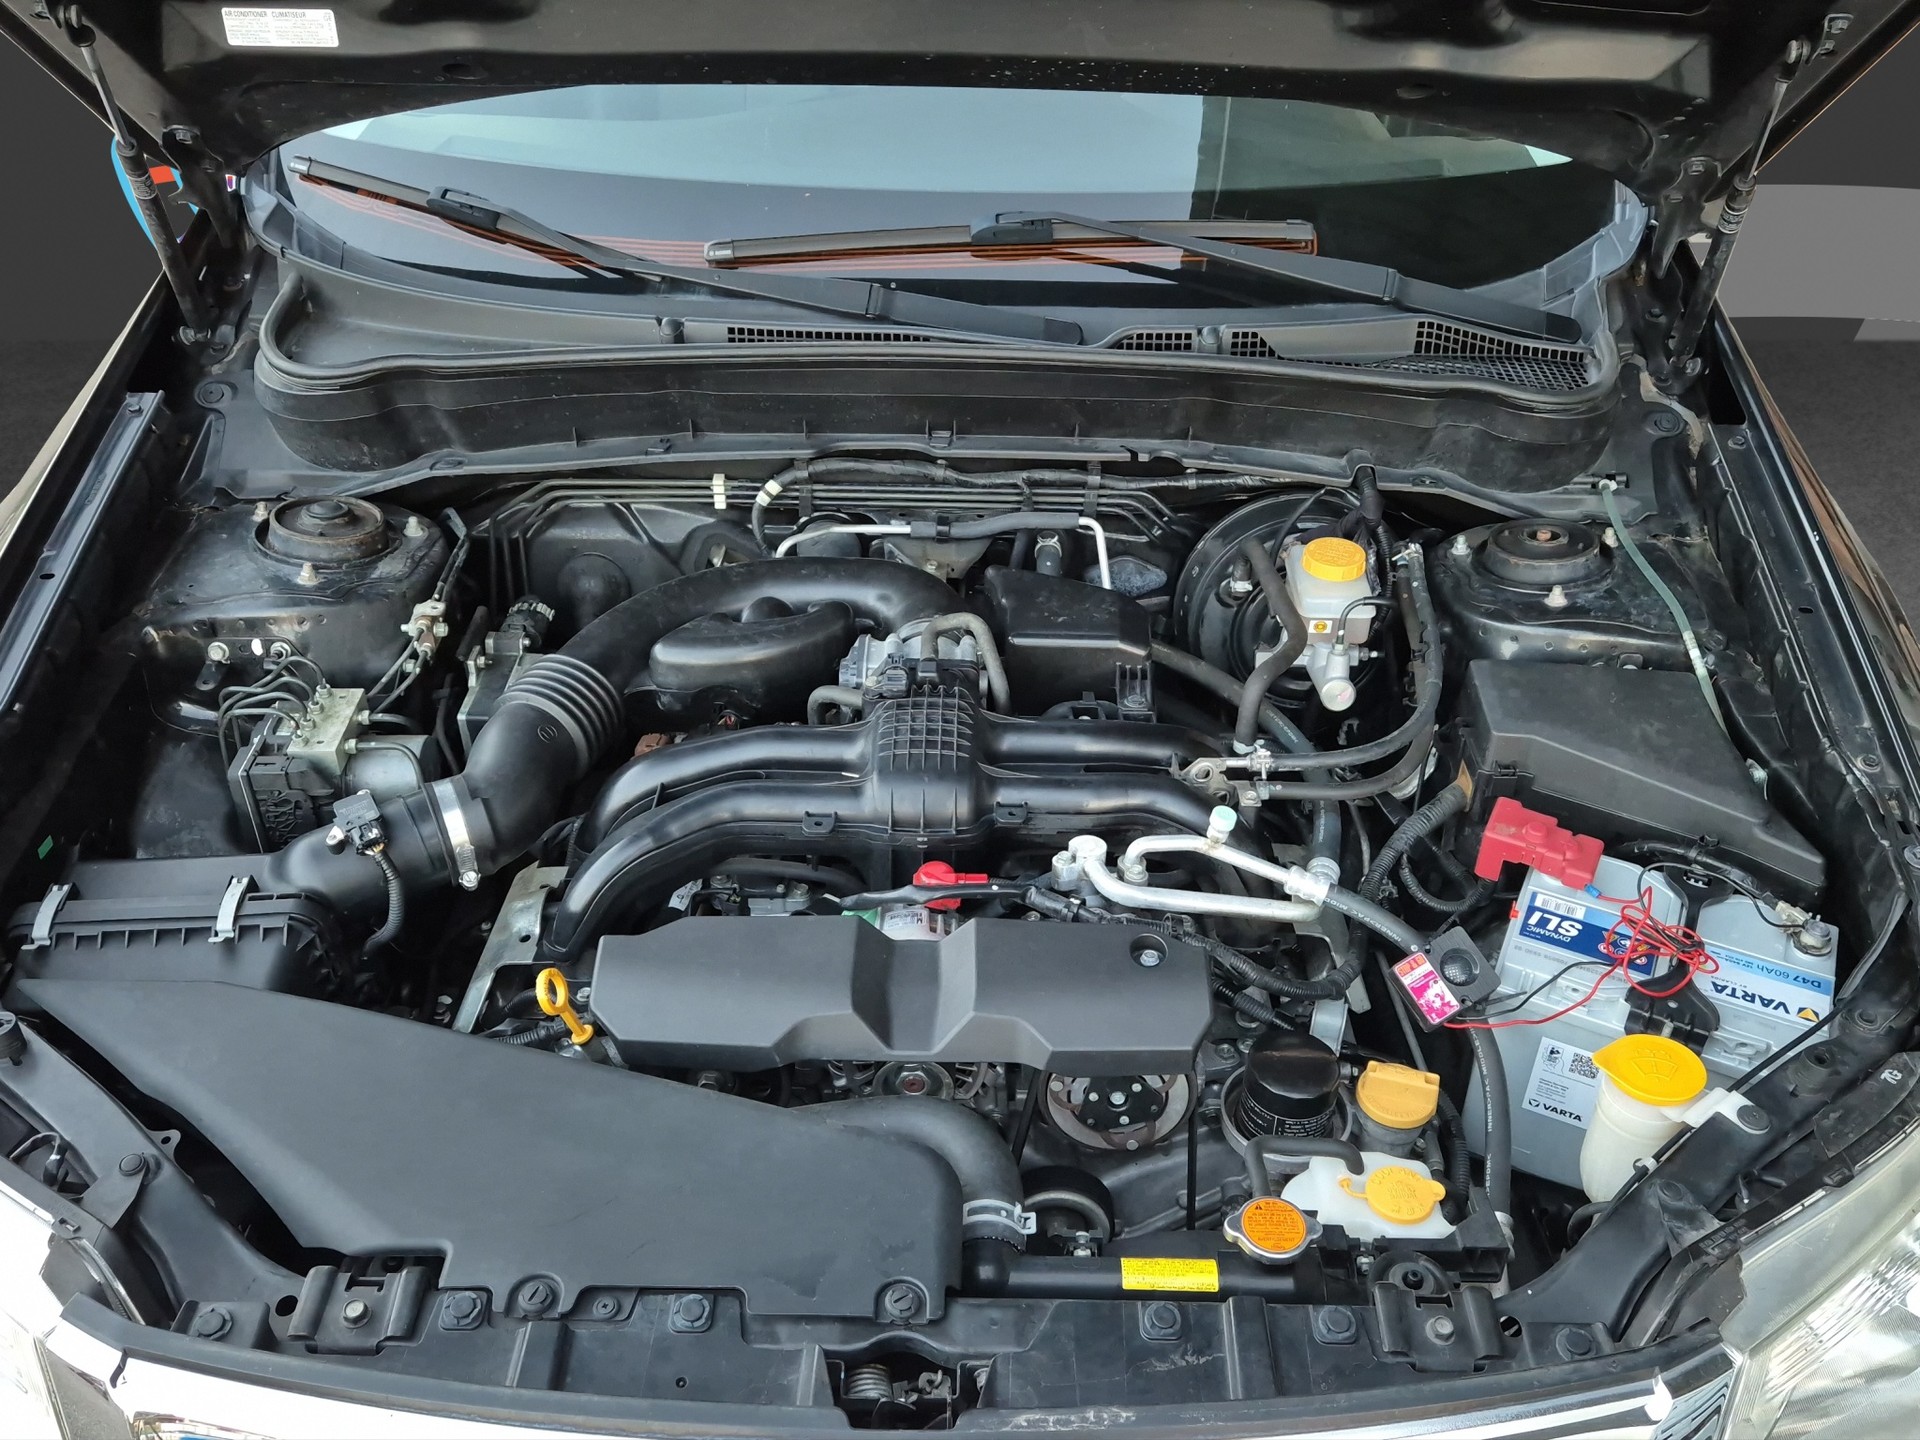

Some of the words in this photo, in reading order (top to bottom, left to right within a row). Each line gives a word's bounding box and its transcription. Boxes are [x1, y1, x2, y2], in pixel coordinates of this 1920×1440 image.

[224, 10, 233, 18] AIR
[233, 10, 268, 18] CONDITIONER
[271, 11, 307, 19] CLIMATISEUR
[1527, 911, 1583, 938] SLI
[1526, 924, 1571, 943] DYNAMIC
[1757, 964, 1790, 980] 60Ah
[1792, 975, 1822, 989] D47
[1711, 981, 1791, 1015] VARTA
[1542, 1102, 1582, 1122] VARTA
